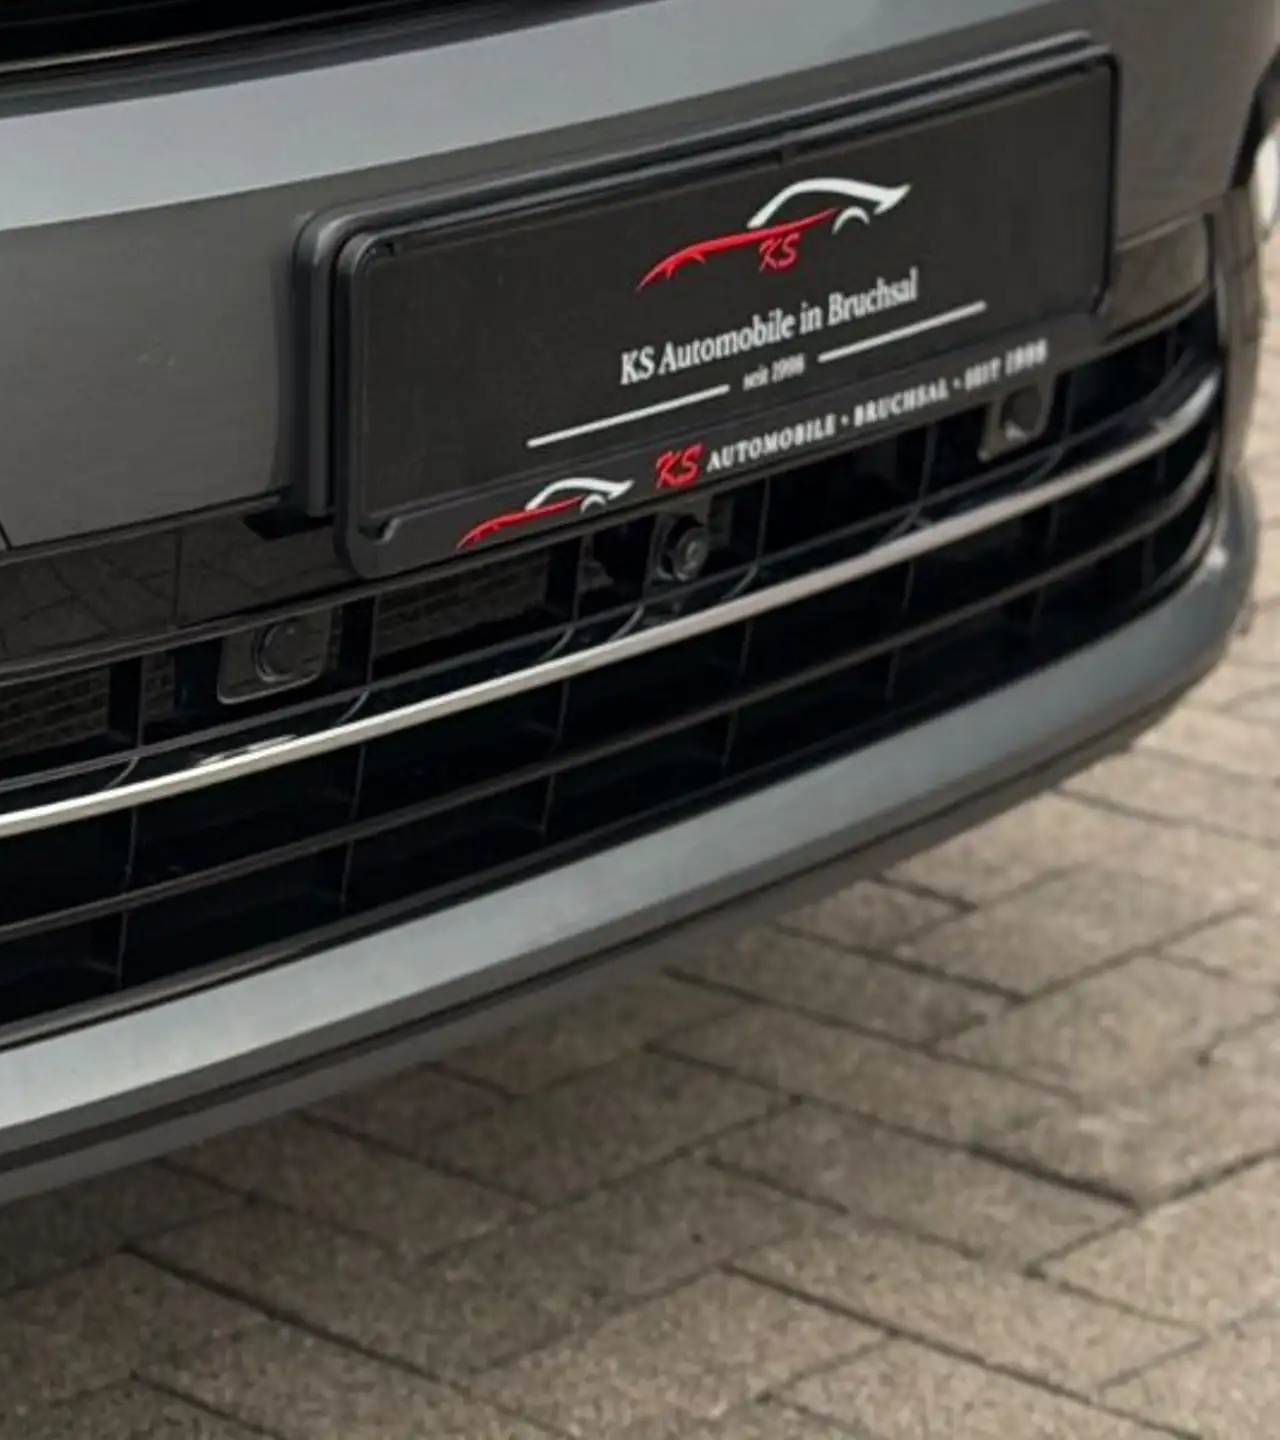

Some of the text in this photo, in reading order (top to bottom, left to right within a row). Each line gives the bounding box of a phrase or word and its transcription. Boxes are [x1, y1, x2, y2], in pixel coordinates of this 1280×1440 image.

[758, 233, 802, 272] KS
[619, 266, 918, 385] KS Automobile in Bruchsal
[655, 441, 704, 490] KS
[706, 413, 836, 472] AUTOMOBILE
[854, 377, 949, 428] BRUCHSAL
